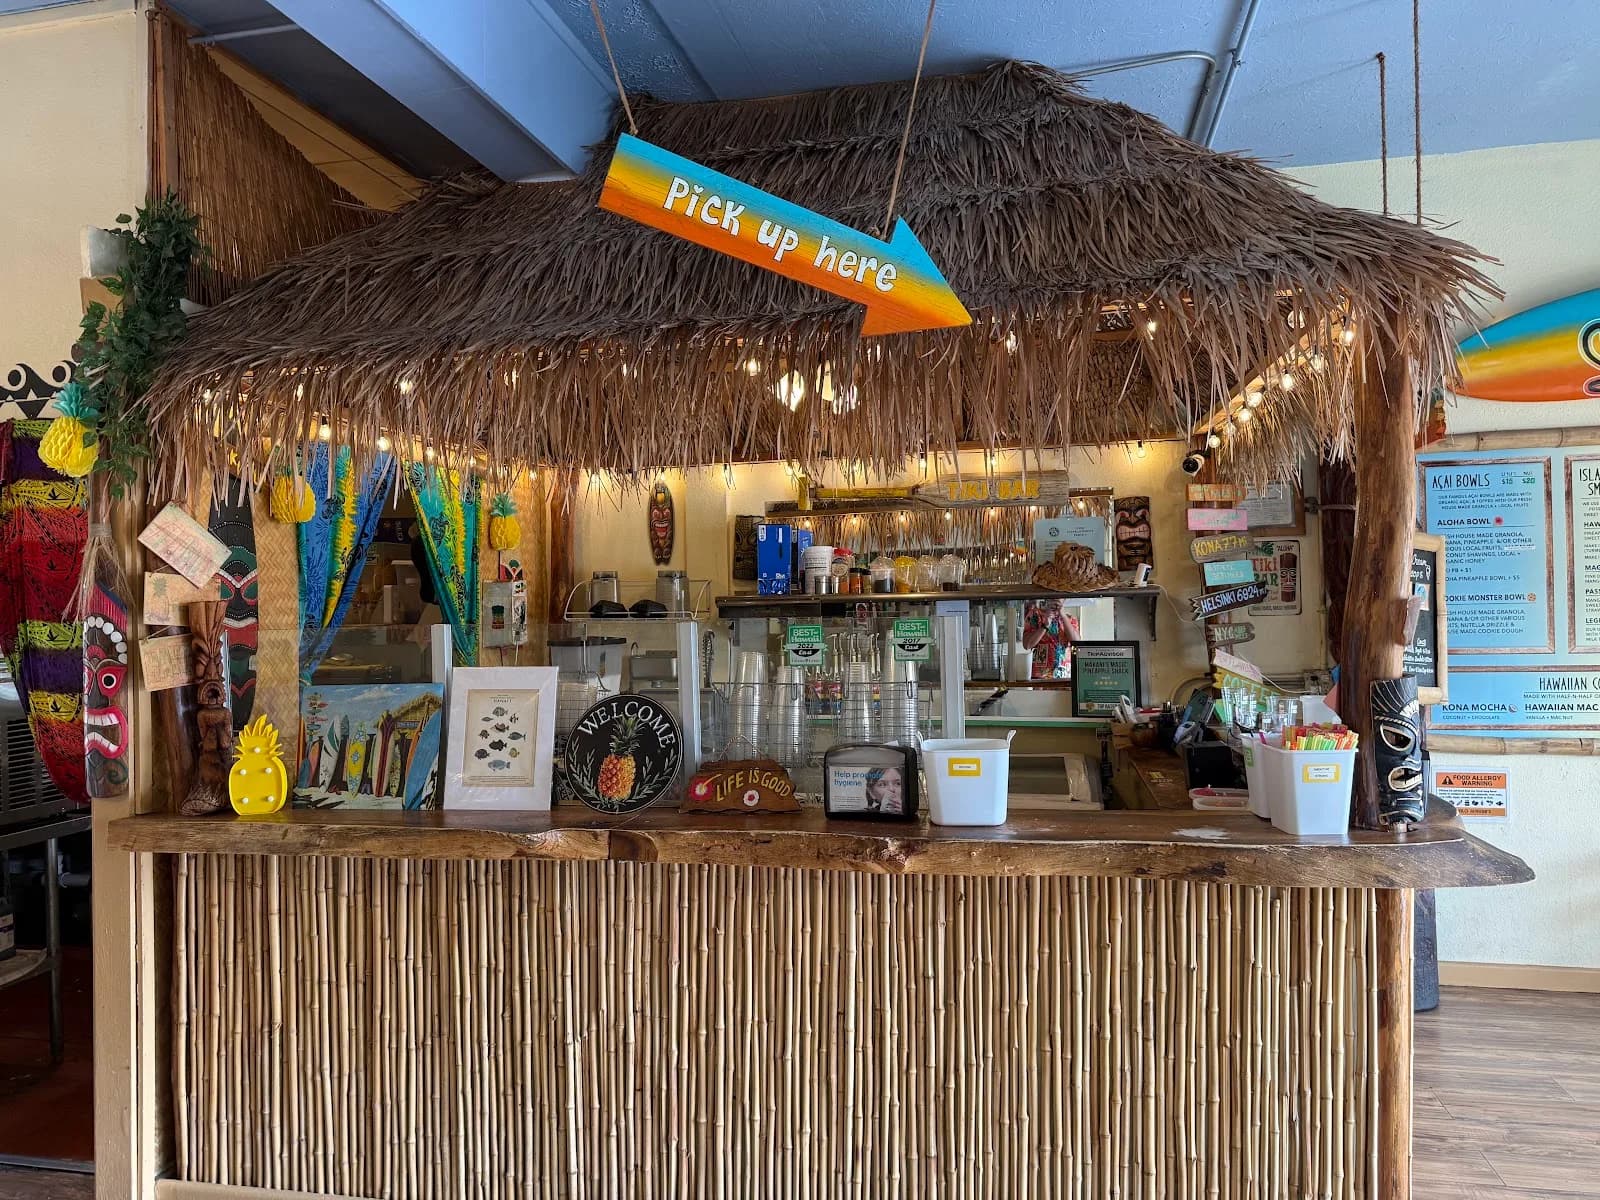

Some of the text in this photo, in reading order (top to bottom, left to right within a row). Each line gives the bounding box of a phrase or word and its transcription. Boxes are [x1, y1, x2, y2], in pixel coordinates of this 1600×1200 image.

[756, 218, 799, 263] up
[812, 235, 898, 292] here
[1432, 474, 1452, 489] AÇAI
[1456, 473, 1490, 488] BOWLS
[946, 479, 1040, 500] TIKI BAR
[1194, 540, 1221, 557] KONA
[1200, 590, 1237, 614] HELSINKI
[793, 628, 814, 637] BEST
[899, 623, 920, 631] BEST
[1539, 677, 1587, 691] HAWAIIAN
[1442, 703, 1507, 711] KONA MOCHA
[1525, 703, 1599, 711] HAWAIIAN MAC
[577, 701, 676, 748] WELCOME
[834, 770, 851, 780] Help
[715, 768, 791, 801] LIFE IS GOOD
